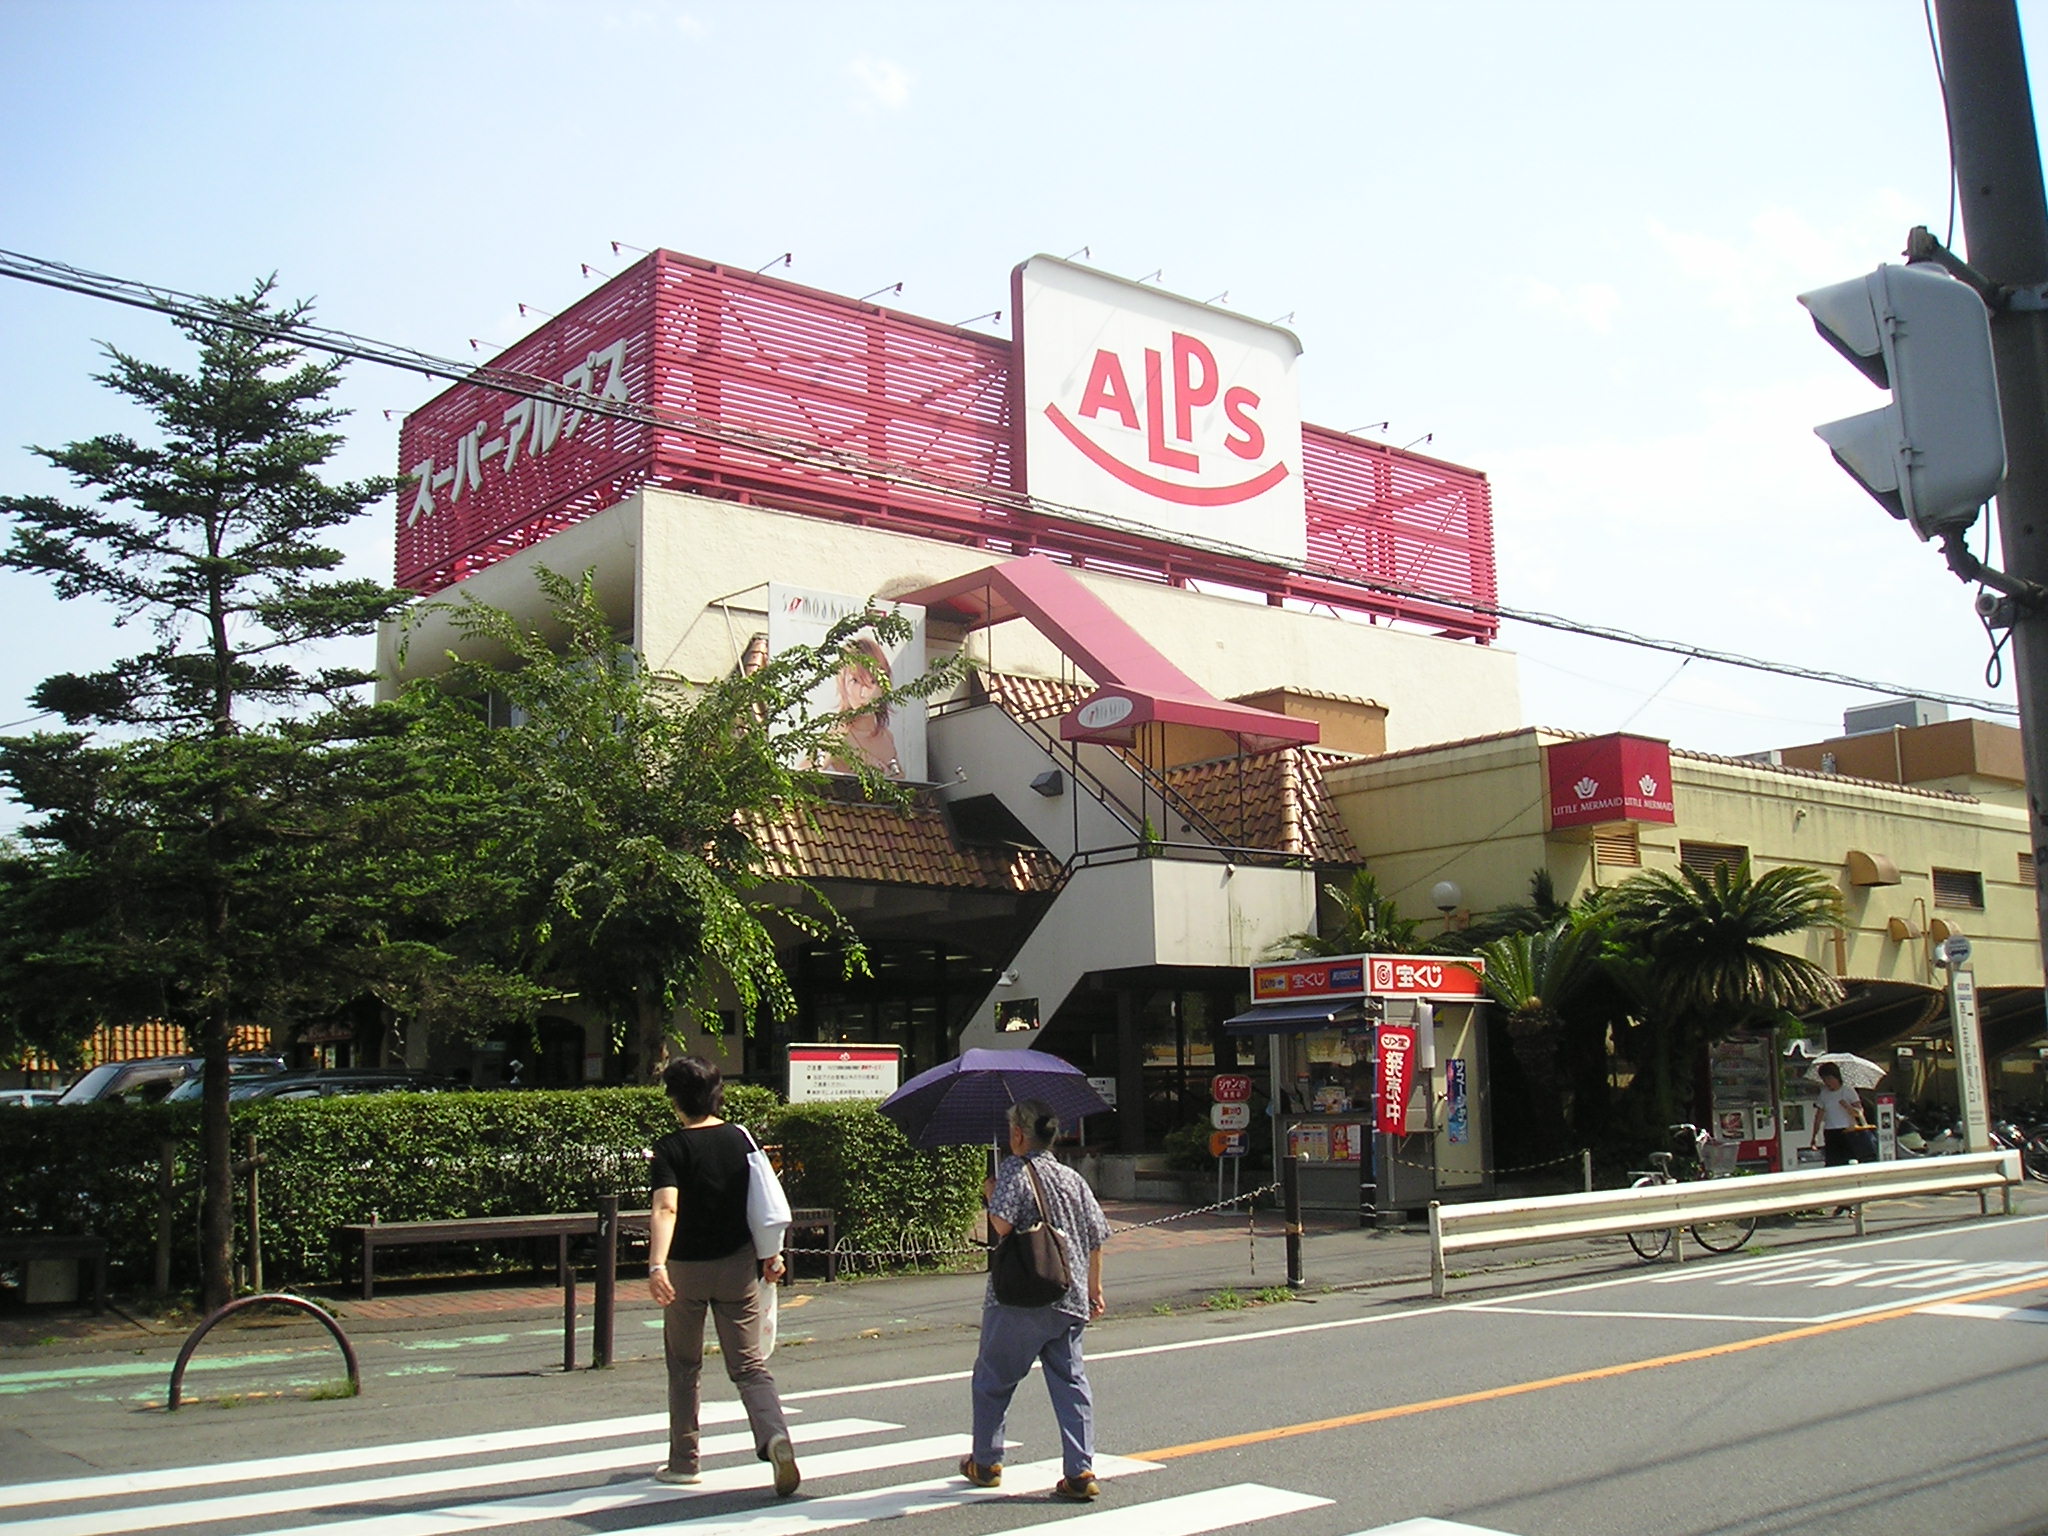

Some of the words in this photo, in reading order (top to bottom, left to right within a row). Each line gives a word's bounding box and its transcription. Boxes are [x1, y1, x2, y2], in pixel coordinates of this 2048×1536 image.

[1078, 331, 1265, 474] ALPS
[406, 337, 630, 528] スーパーアルプス
[1553, 804, 1577, 816] LITTLE
[1580, 797, 1623, 811] MERMAID
[1292, 972, 1325, 988] 宝くじ
[1396, 964, 1442, 988] 宝くじ
